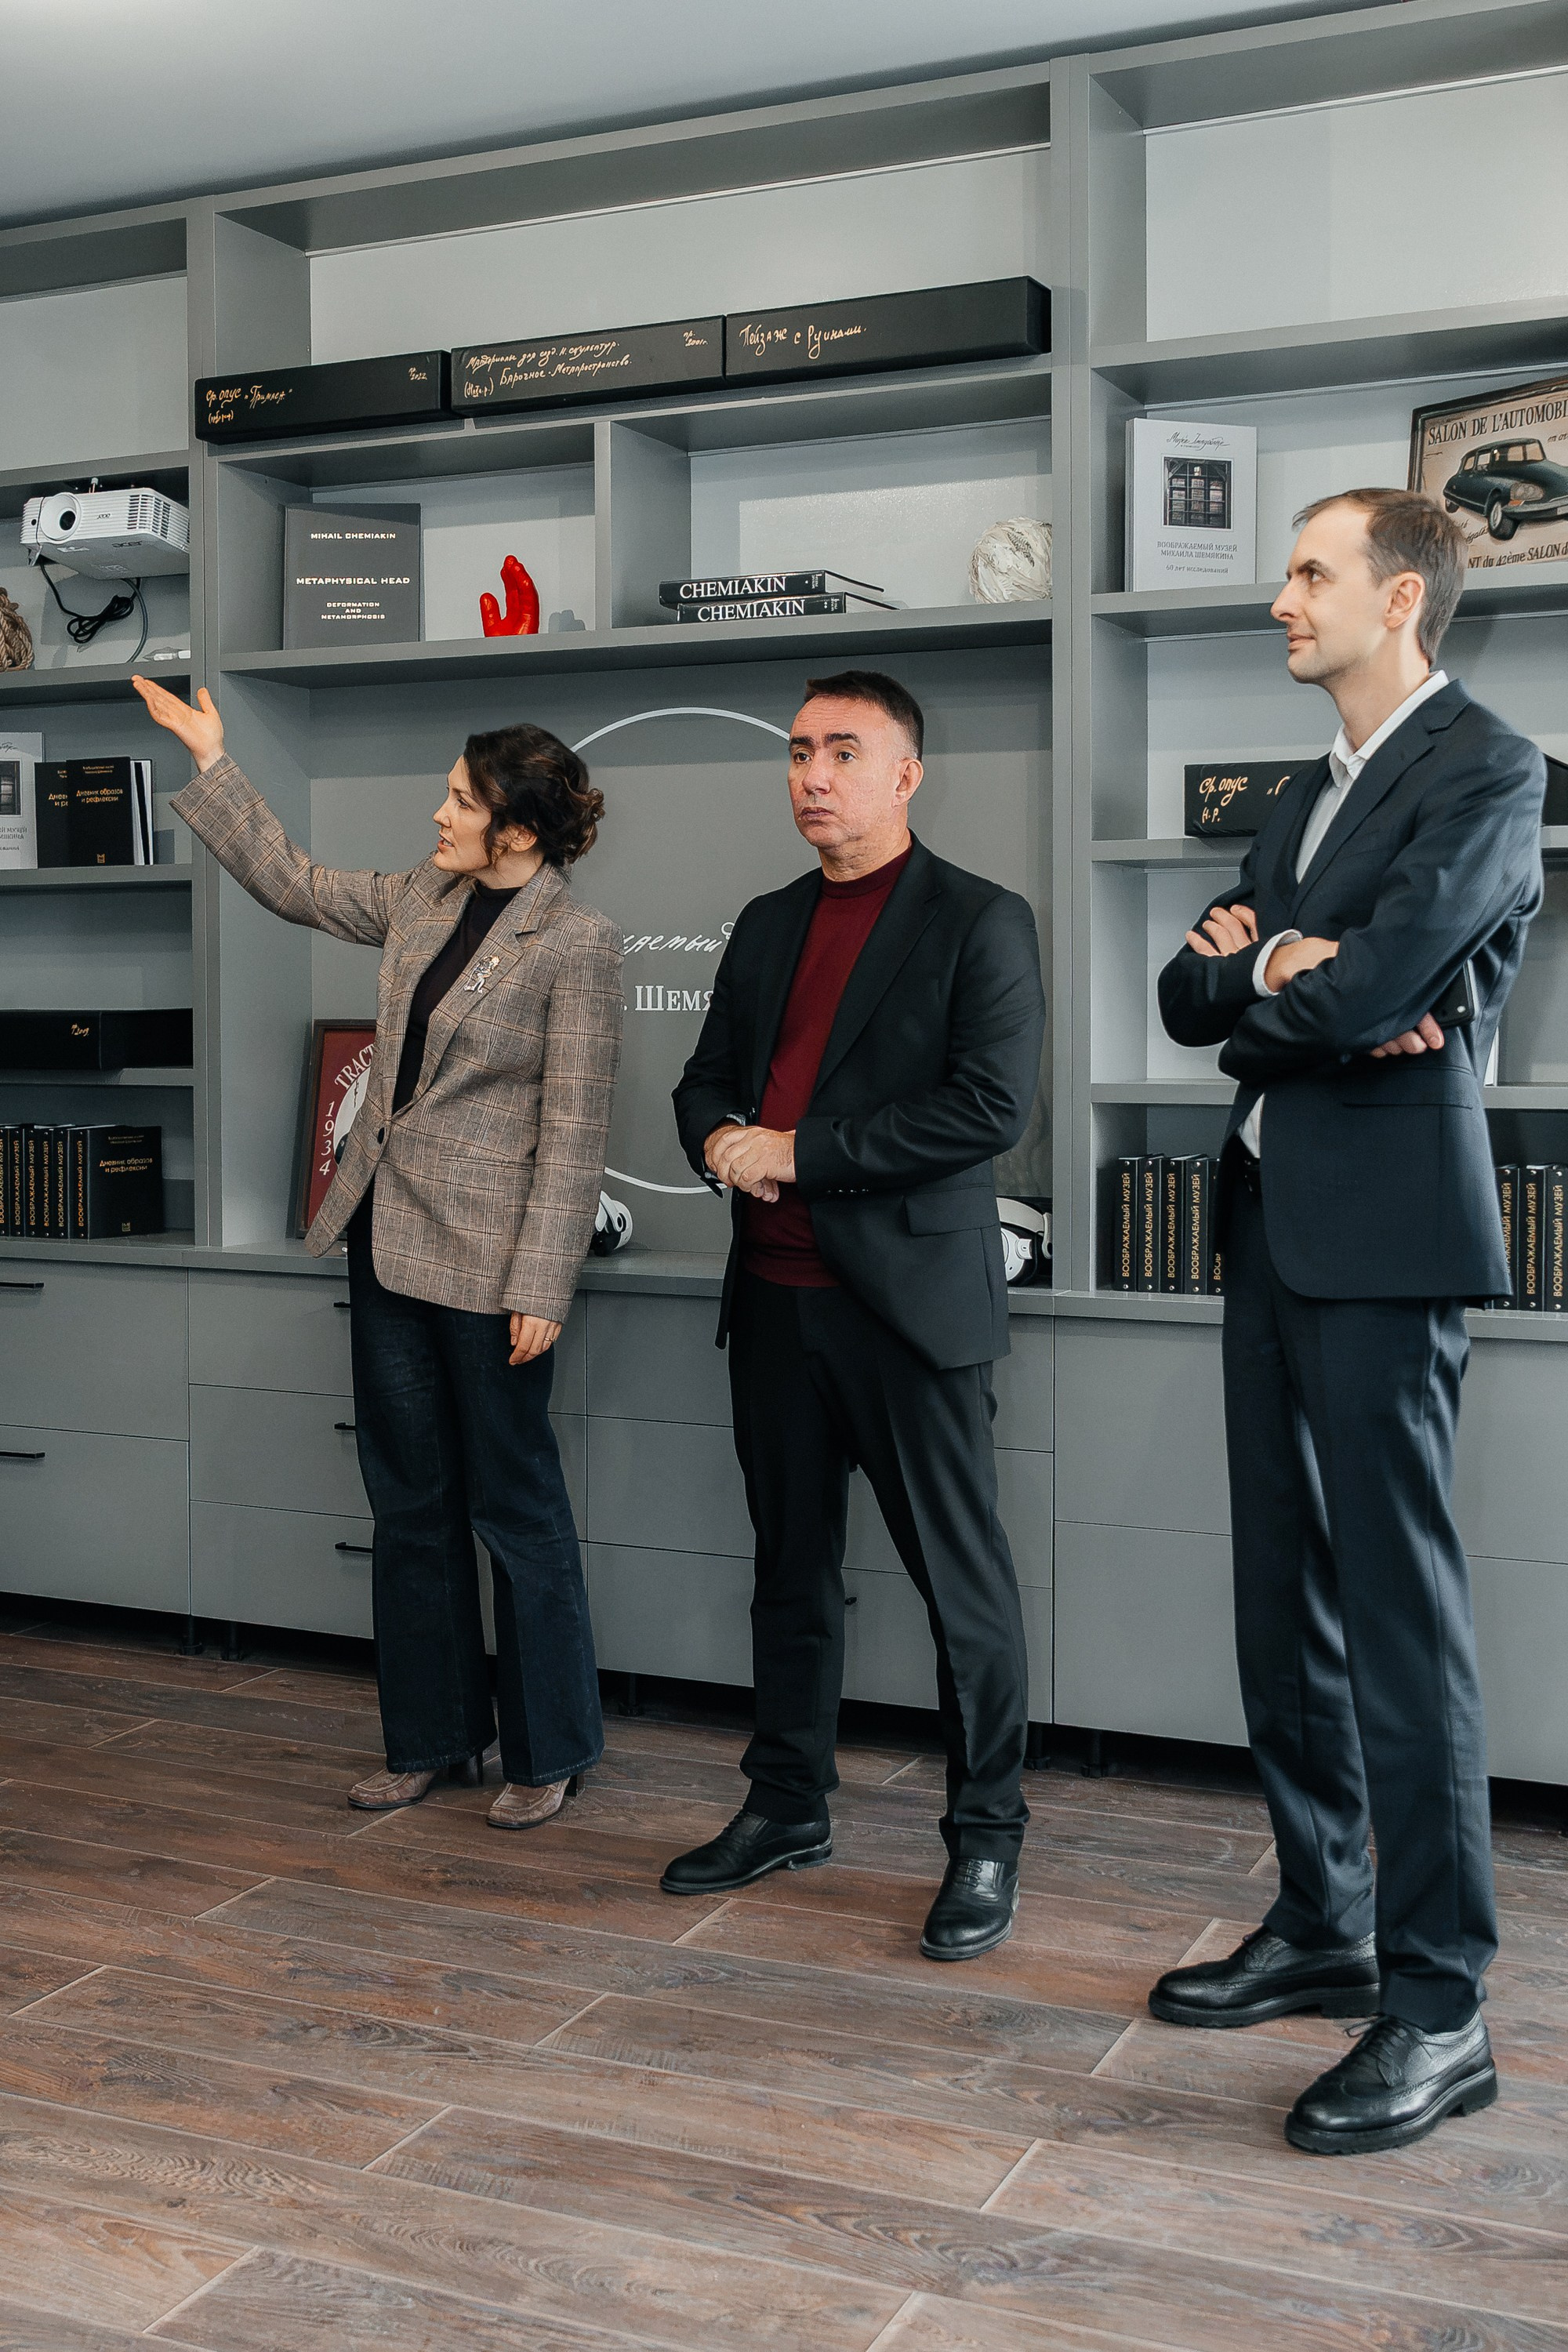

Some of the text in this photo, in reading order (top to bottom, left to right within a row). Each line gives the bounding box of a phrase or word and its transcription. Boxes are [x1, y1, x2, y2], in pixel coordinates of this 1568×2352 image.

[1428, 420, 1468, 446] SALON
[1472, 417, 1487, 437] DE
[679, 576, 786, 598] CHEMIAKIN
[1526, 543, 1561, 561] SALON
[697, 599, 805, 622] CHEMIAKIN
[1121, 1173, 1131, 1277] ВООБРАЖАЕМЫЙ МУЗЕЙ
[1144, 1172, 1153, 1277] ВООБРАЖАЕМЫЙ МУЗЕЙ
[1167, 1173, 1175, 1278] ВООБРАЖАЕМЫЙ МУЗЕЙ
[1191, 1174, 1200, 1279] ВООБРАЖАЕМЫЙ МУЗЕЙ
[1501, 1182, 1512, 1214] МУЗЕЙ
[1526, 1183, 1537, 1294] ВООБРАЖАЕМЫЙ МУЗЕЙ
[1552, 1185, 1563, 1297] ВООБРАЖАЕМЫЙ МУЗЕЙ
